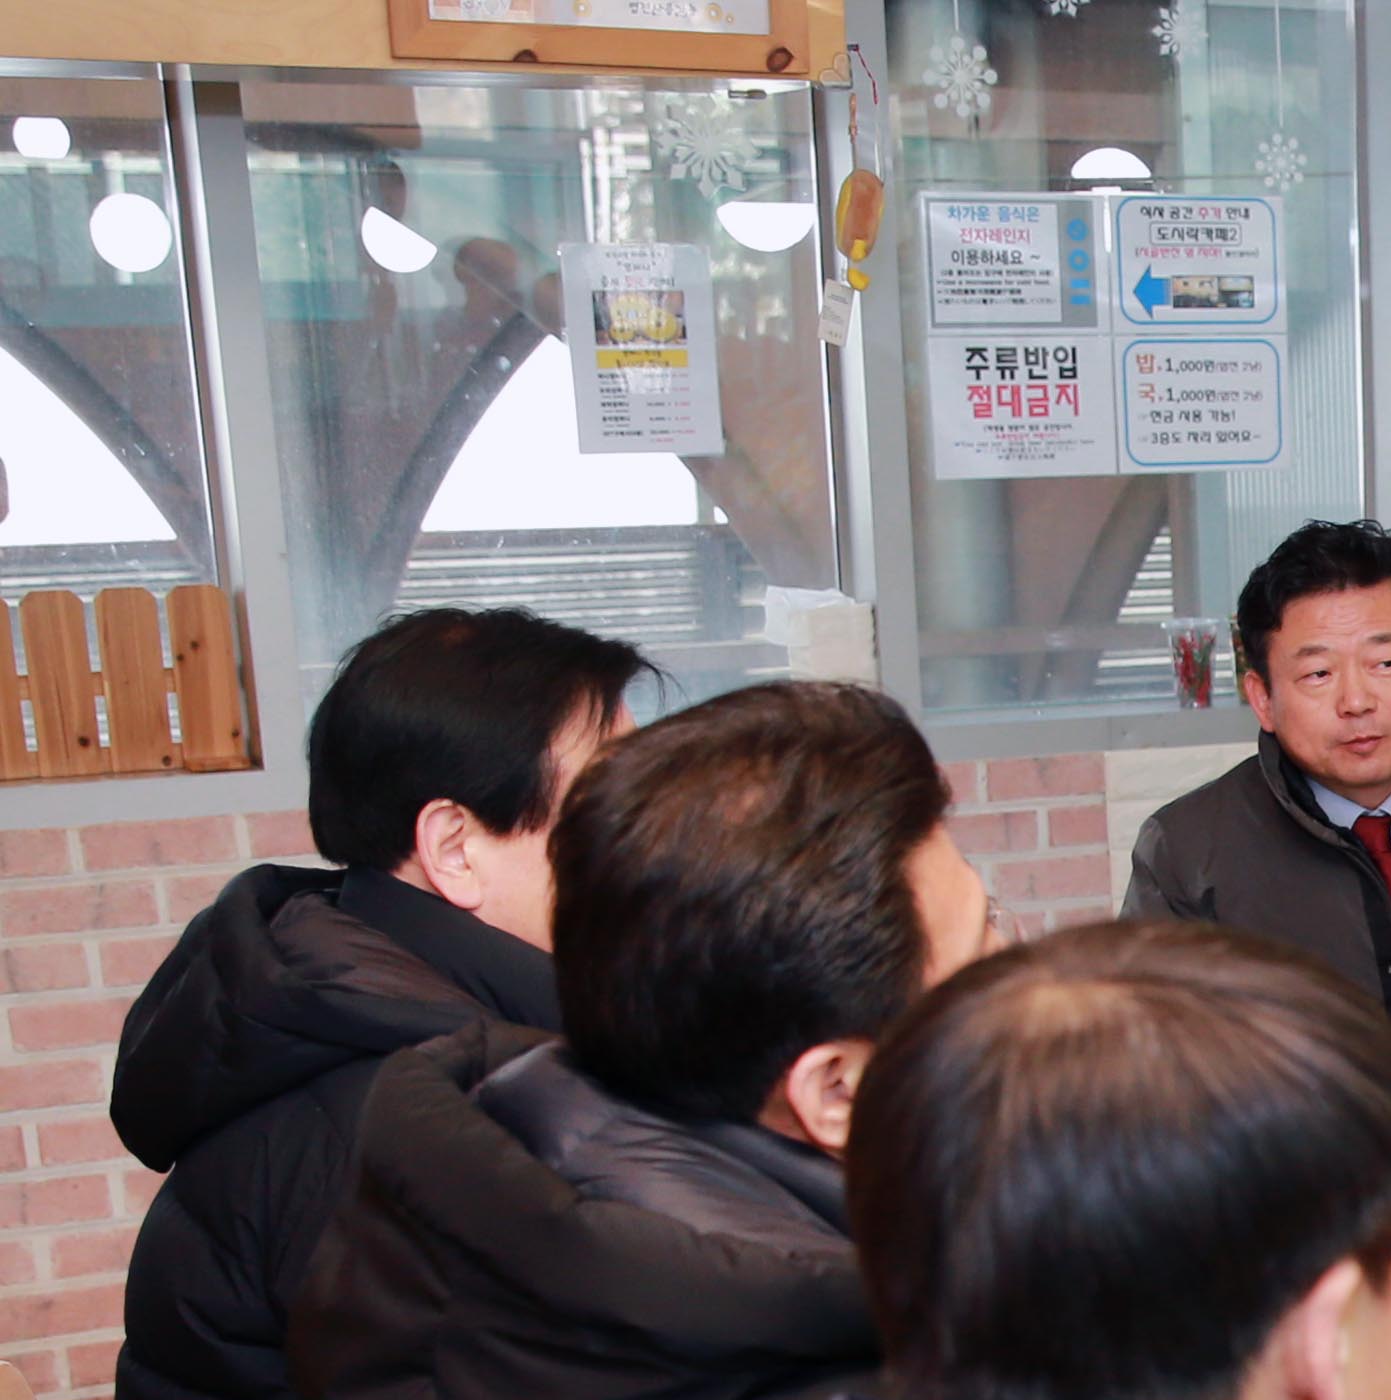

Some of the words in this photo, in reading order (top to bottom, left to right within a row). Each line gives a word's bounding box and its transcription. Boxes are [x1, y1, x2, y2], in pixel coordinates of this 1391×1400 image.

[948, 205, 990, 222] 차가운
[998, 206, 1040, 222] 음식은
[960, 228, 1031, 244] 전자레인지
[951, 250, 1024, 265] 이용하세요
[965, 346, 1078, 381] 주류반입
[967, 383, 1079, 419] 절대금지
